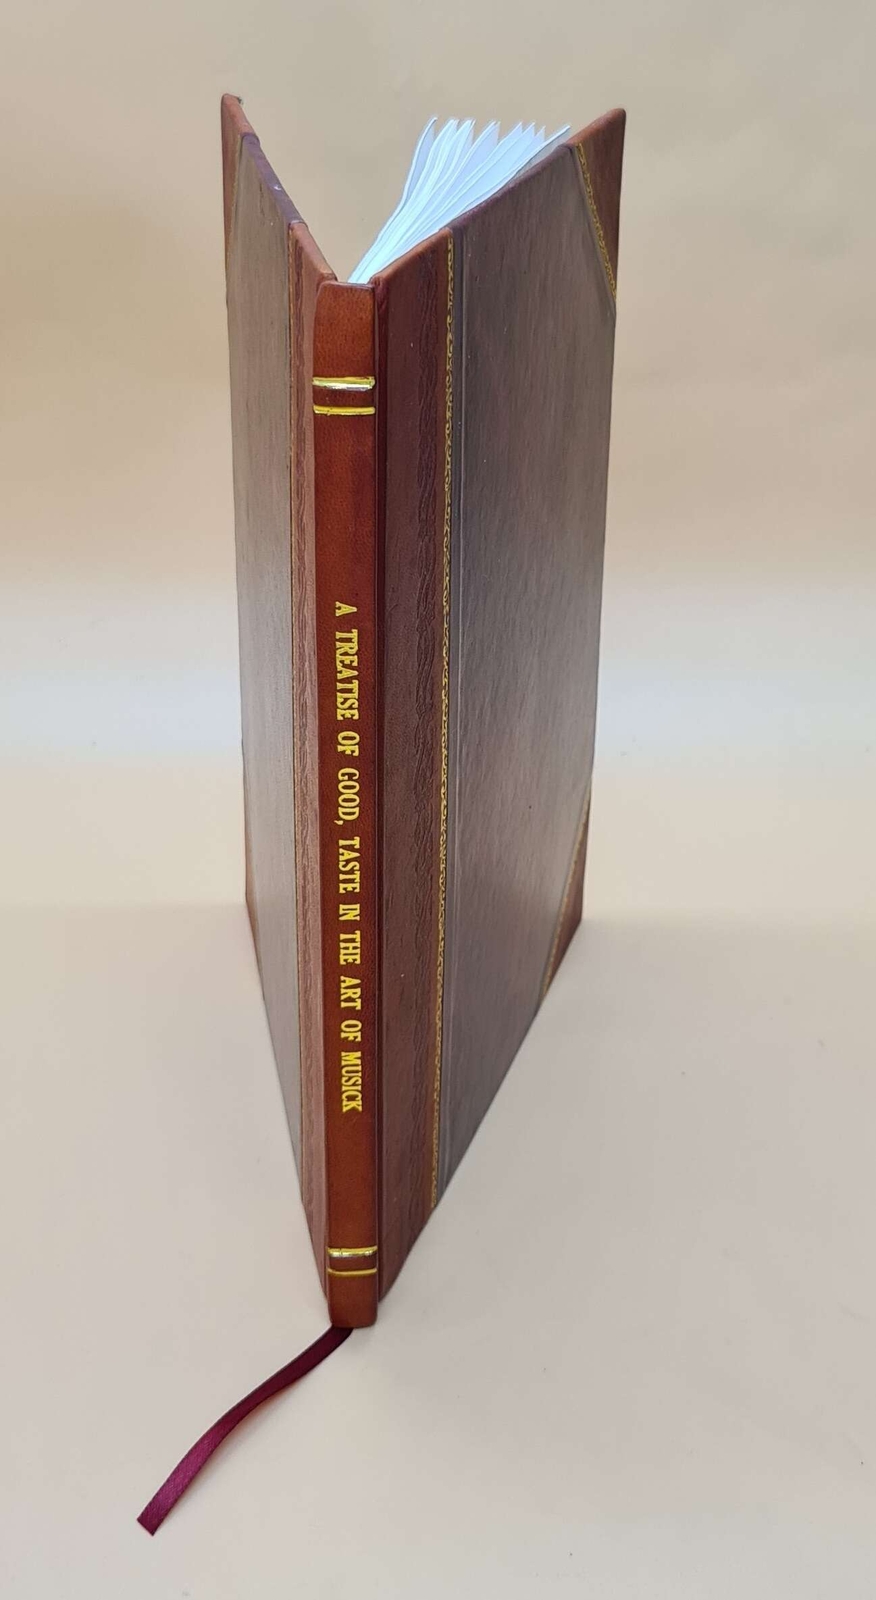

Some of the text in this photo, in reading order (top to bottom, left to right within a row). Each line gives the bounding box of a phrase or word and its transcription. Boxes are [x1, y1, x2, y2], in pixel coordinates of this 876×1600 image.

[334, 601, 363, 1113] A TREATISE OF GOOD, TASTE IN THE ART OF MUSICK
